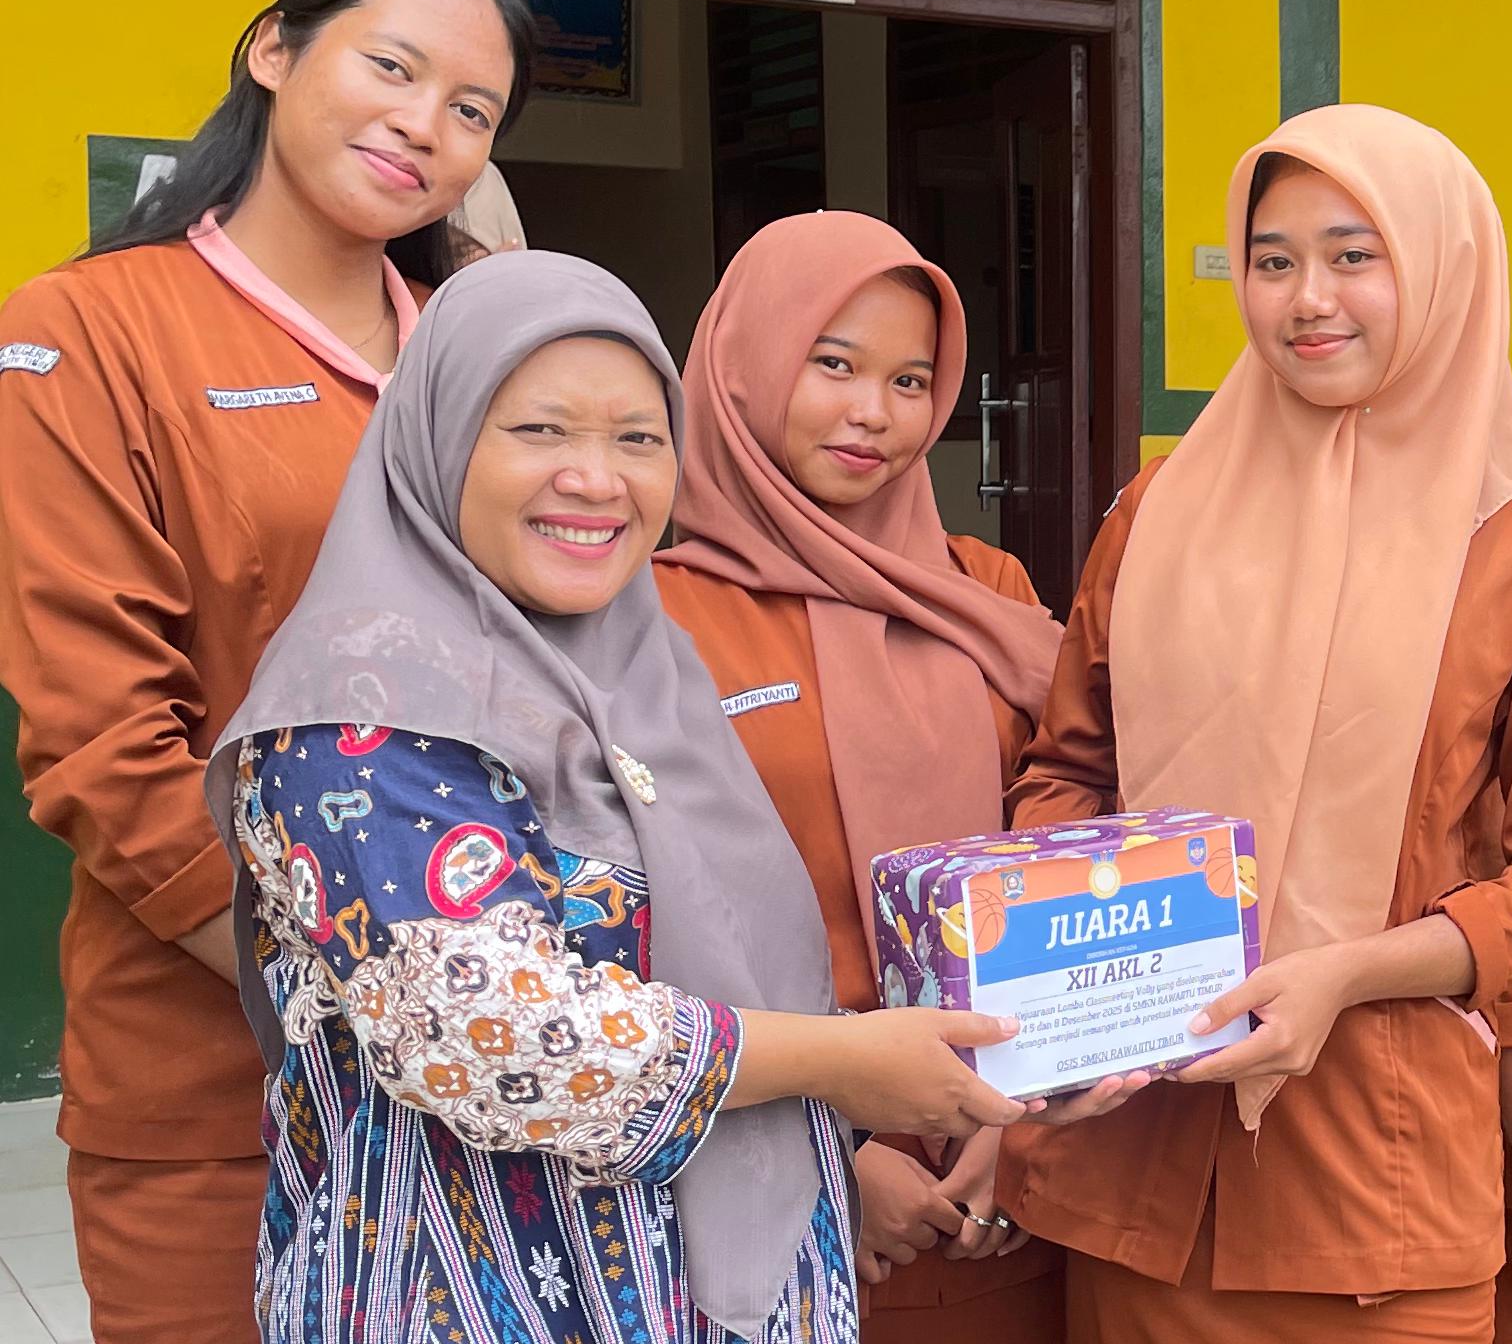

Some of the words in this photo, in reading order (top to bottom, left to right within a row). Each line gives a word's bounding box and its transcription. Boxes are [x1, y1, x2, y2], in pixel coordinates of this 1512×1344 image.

[735, 686, 796, 710] FITRIYANTI
[1046, 900, 1151, 950] JUARA
[1159, 895, 1172, 928] 1
[1066, 966, 1097, 991] XII
[1102, 957, 1144, 987] AKL
[1150, 953, 1163, 974] 2
[1058, 1000, 1083, 1013] Lomba
[1156, 981, 1175, 995] yang
[1037, 1021, 1051, 1032] dan
[1015, 1037, 1047, 1051] Semoga
[1056, 1057, 1079, 1072] OSIS
[1080, 1049, 1109, 1067] SMKN
